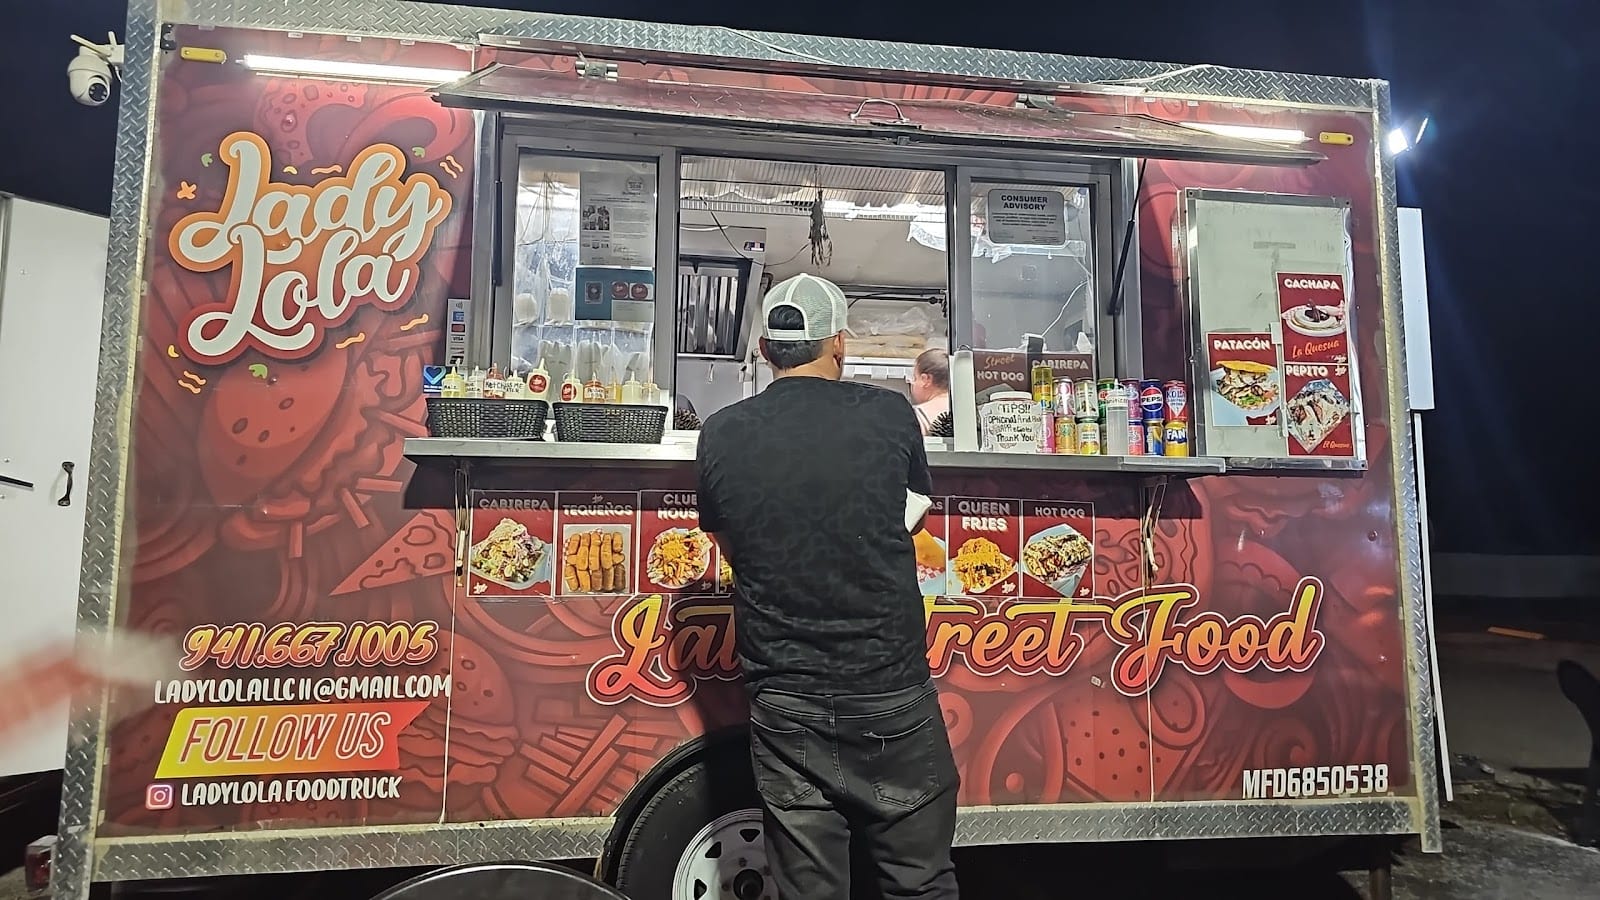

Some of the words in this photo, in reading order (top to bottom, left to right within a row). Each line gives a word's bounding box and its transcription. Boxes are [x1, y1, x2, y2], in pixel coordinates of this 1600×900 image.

[174, 135, 447, 266] Lady
[1000, 194, 1048, 203] CONSUMER
[185, 223, 413, 359] Lola
[1284, 279, 1340, 290] CACHAPA
[1213, 337, 1271, 350] PATACÓN
[1292, 344, 1303, 358] La
[985, 353, 1016, 369] Street
[1032, 359, 1089, 369] CABIREPA
[977, 371, 998, 380] HOT
[1001, 372, 1025, 381] DOG
[1286, 365, 1329, 377] PEPITO
[1166, 428, 1186, 440] FAN
[479, 498, 550, 511] CABIREPA
[562, 502, 633, 516] TEQUEÑOS
[958, 501, 1010, 515] QUEEN
[657, 507, 699, 520] HOUS
[1035, 507, 1059, 517] HOT
[1060, 508, 1085, 518] DOG
[962, 516, 1008, 531] FRIES
[1112, 578, 1323, 693] Food
[181, 622, 438, 670] 941.667.1005
[179, 713, 336, 764] FOLLOW
[335, 711, 392, 760] US
[1242, 763, 1389, 799] MFD6850538
[181, 776, 403, 806] LADYLOLA.FOODTRUCK
